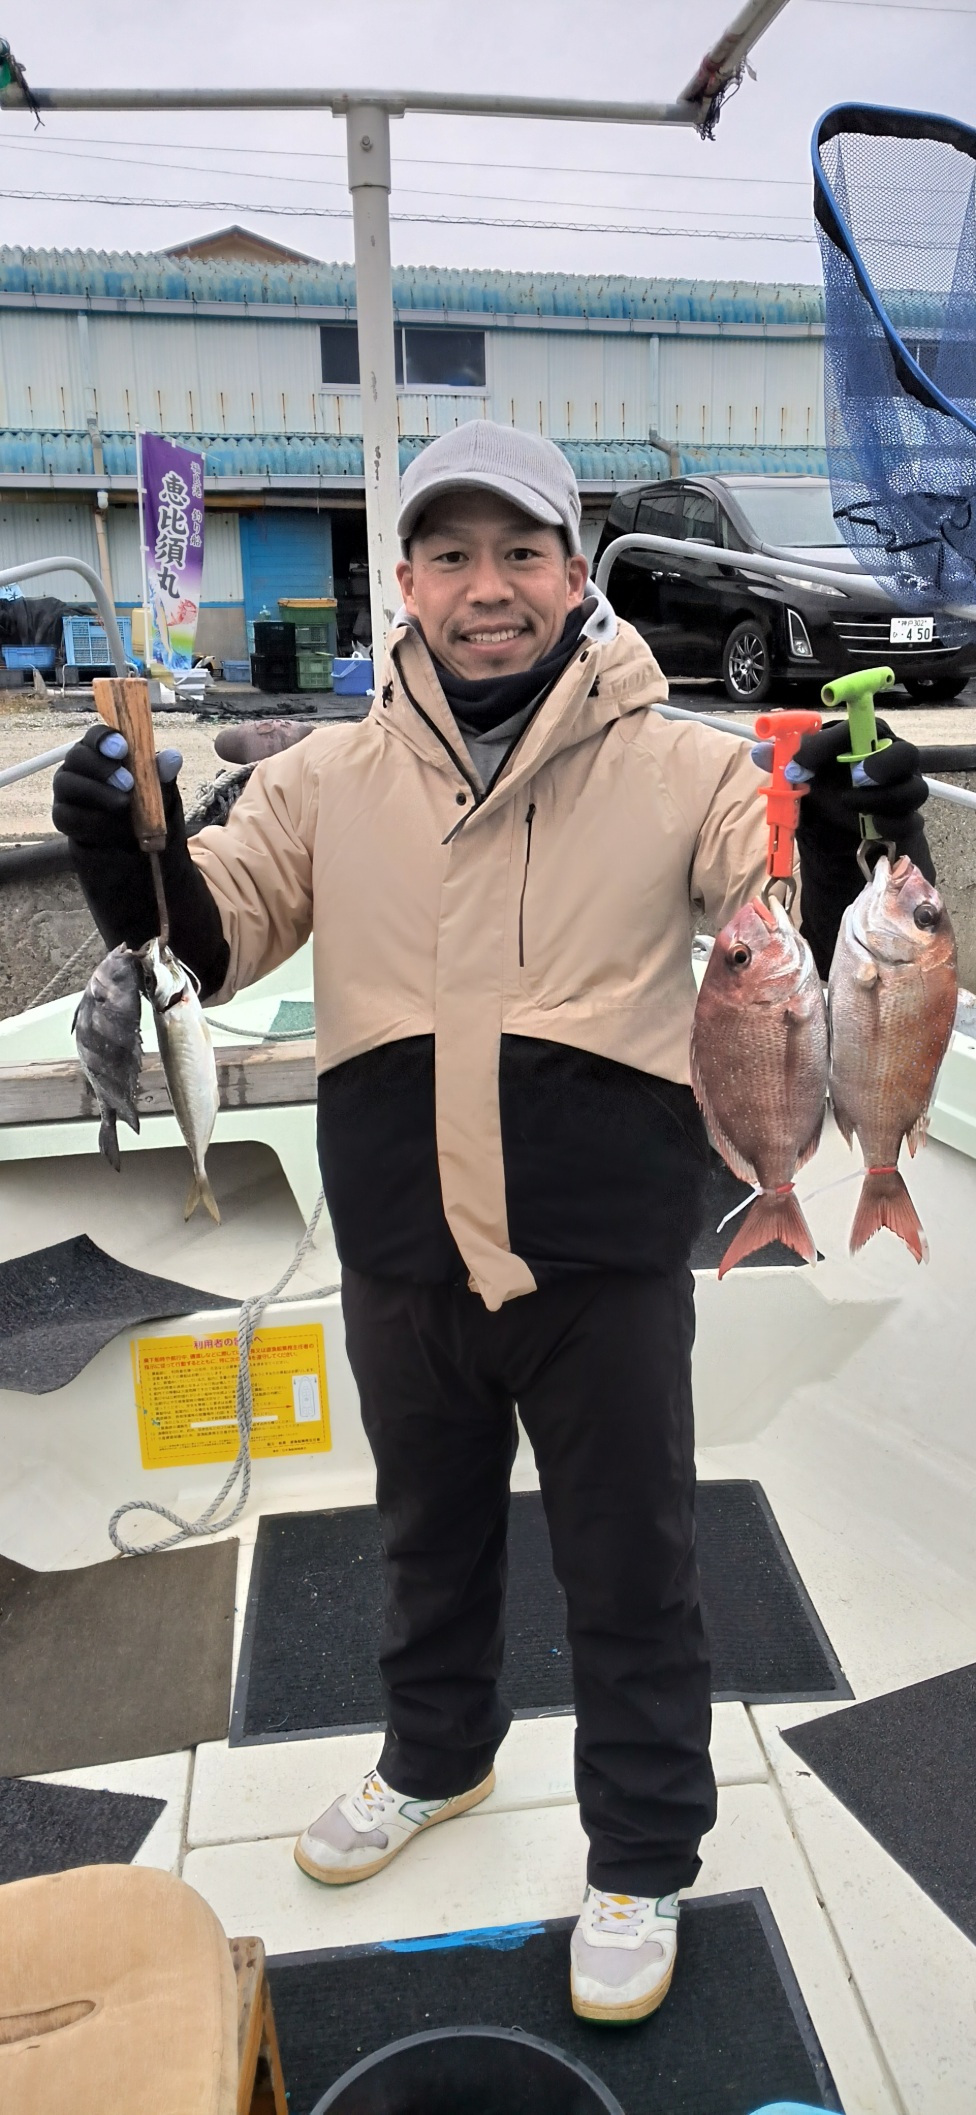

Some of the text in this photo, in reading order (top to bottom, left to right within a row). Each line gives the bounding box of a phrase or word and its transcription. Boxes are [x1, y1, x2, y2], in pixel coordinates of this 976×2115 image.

[155, 471, 189, 599] 恵比須丸
[190, 508, 202, 547] 釣り船
[193, 1336, 263, 1350] 利用者の皆へ
